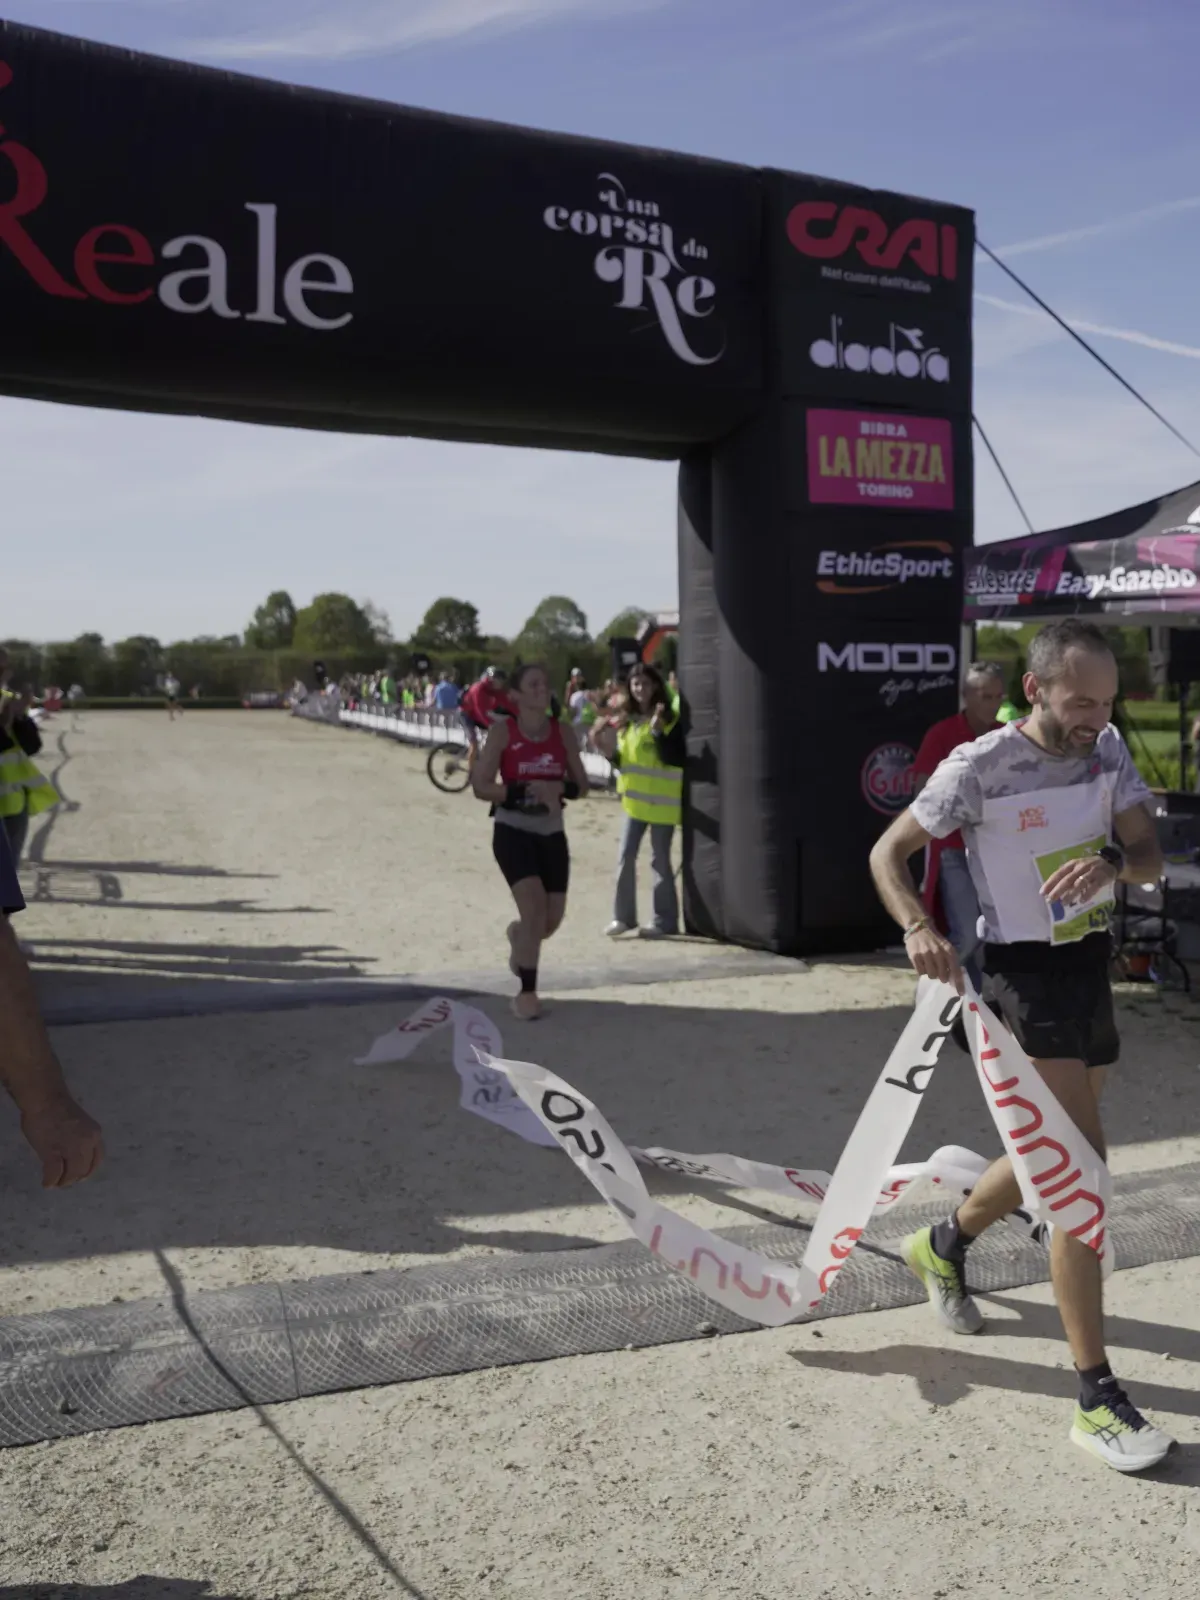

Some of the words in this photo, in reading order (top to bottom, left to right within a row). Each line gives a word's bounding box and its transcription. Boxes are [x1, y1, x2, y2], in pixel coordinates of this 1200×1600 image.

[597, 172, 660, 217] Una
[543, 205, 687, 272] corsa
[681, 238, 709, 260] da
[786, 201, 958, 281] CRAI
[594, 244, 727, 366] Re
[810, 314, 950, 382] diadora
[860, 421, 907, 437] BIRRA
[818, 435, 851, 477] LA
[855, 437, 946, 484] MEZZA
[857, 482, 914, 499] TORINO
[817, 551, 953, 583] EthicSport
[1056, 564, 1197, 598] Easy-Gazebo
[818, 643, 956, 672] MOOD
